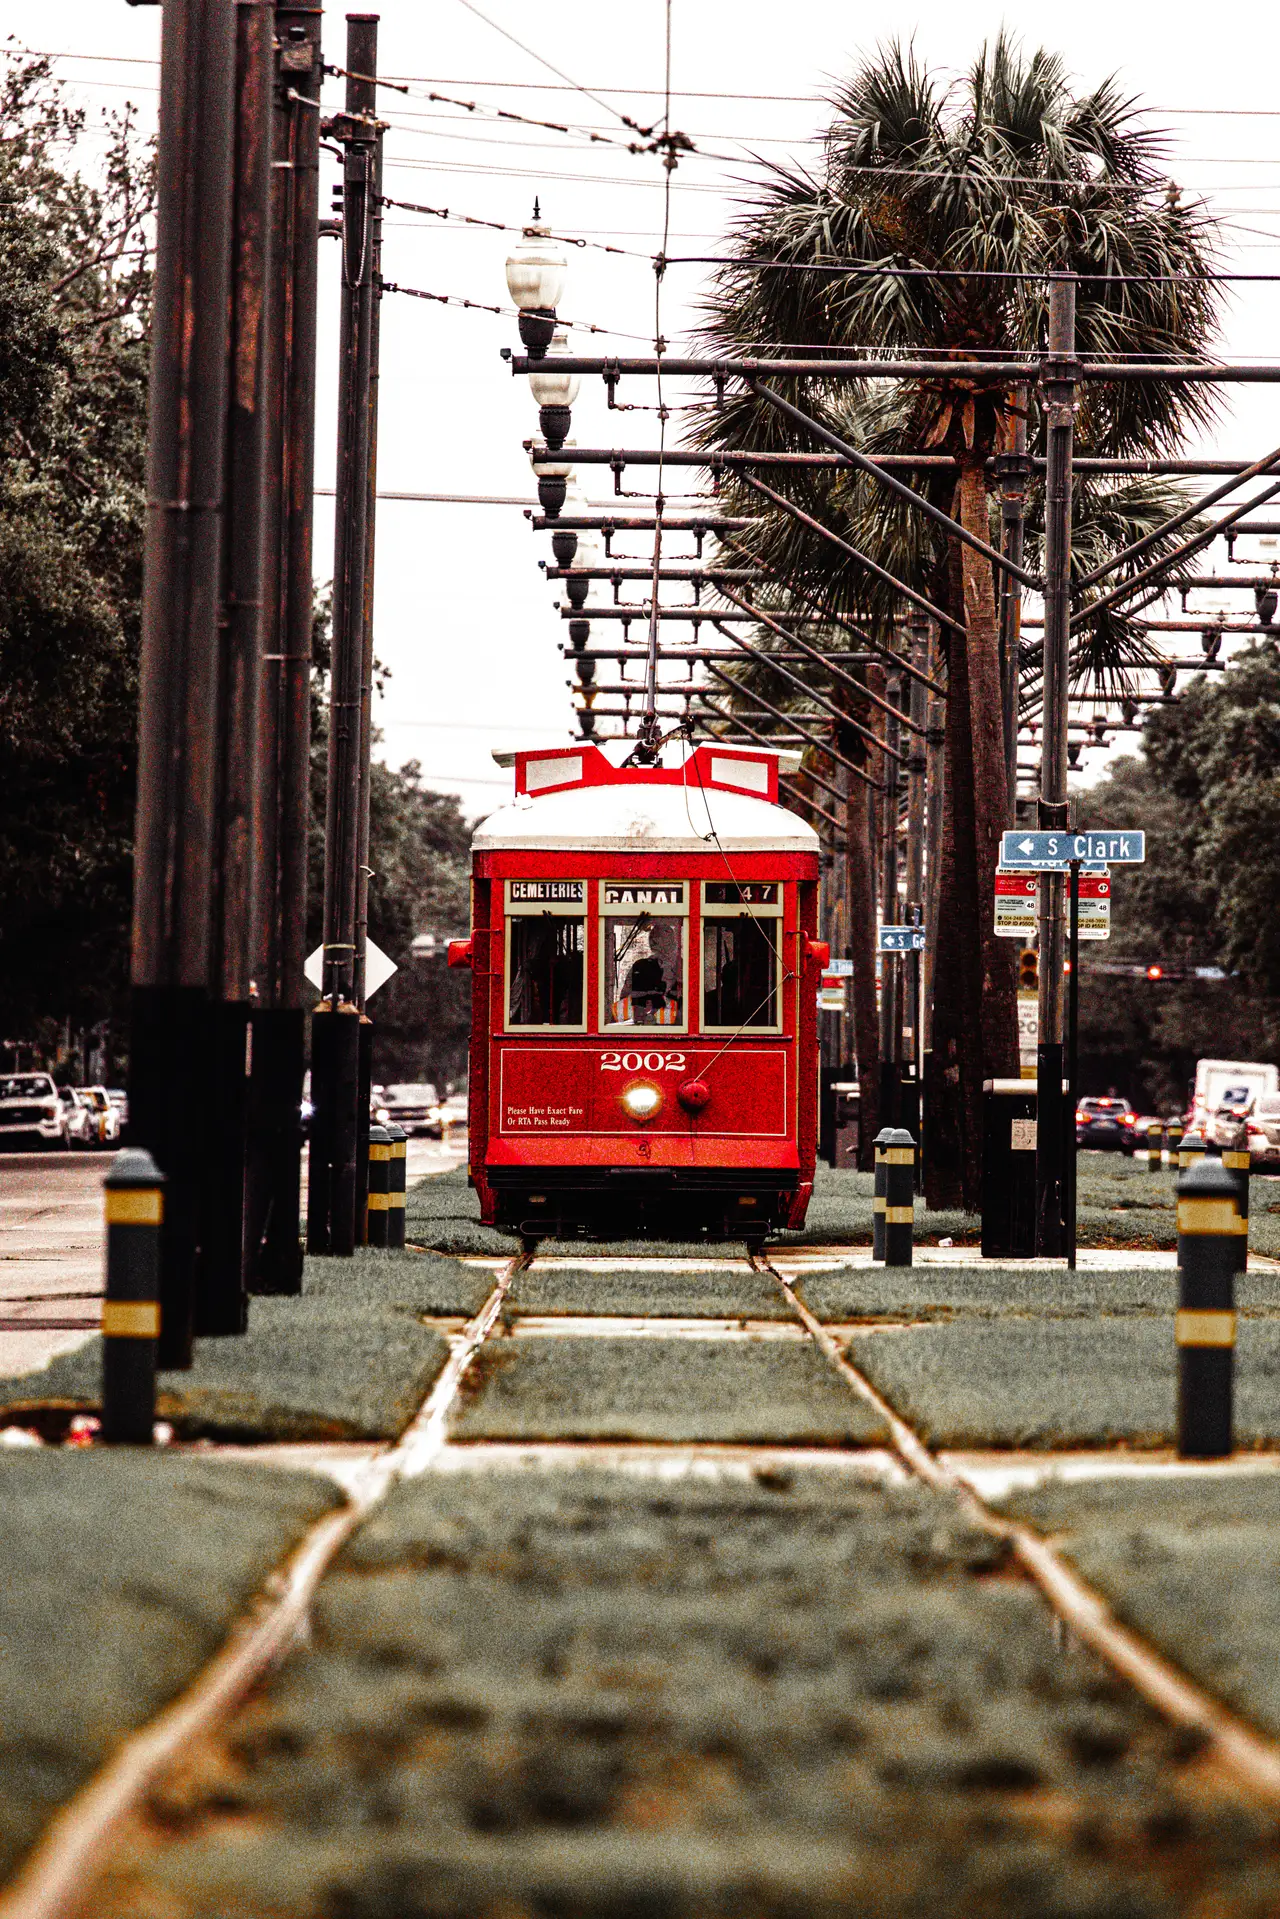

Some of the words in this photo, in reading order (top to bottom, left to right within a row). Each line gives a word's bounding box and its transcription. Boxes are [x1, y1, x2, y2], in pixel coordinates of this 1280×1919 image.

[1047, 838, 1058, 856] S
[1073, 835, 1130, 858] Clark
[512, 882, 583, 898] CEMETERIES
[897, 935, 905, 947] S
[600, 1052, 686, 1071] 2002
[507, 1106, 527, 1115] Please
[529, 1106, 545, 1115] Have
[547, 1106, 566, 1115] Exact
[568, 1106, 583, 1115] Fare
[507, 1117, 516, 1125] Or
[518, 1117, 532, 1125] RTA
[534, 1117, 548, 1125] Pass
[550, 1117, 571, 1127] Ready
